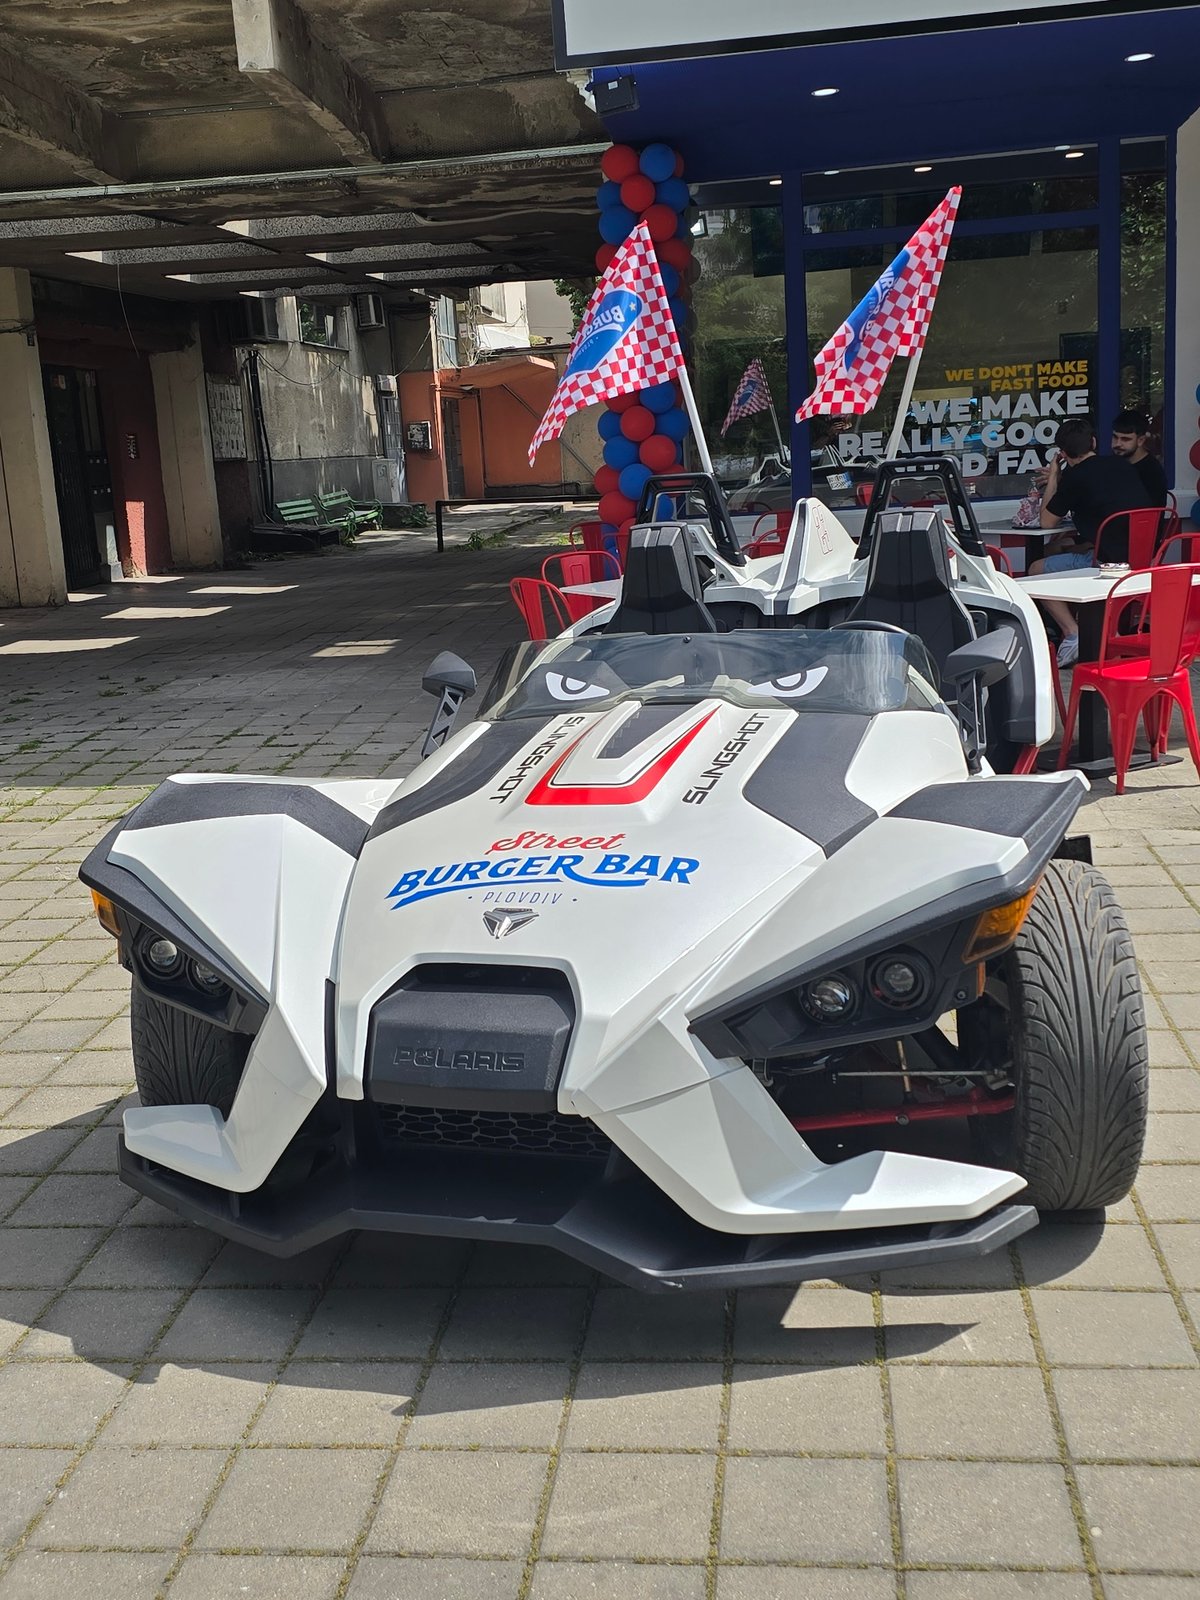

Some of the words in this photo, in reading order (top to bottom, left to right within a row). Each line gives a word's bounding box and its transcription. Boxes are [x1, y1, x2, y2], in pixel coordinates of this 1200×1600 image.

[945, 368, 975, 382] WE
[978, 364, 1034, 379] DON'T
[1037, 360, 1088, 375] MAKE
[991, 377, 1034, 392] FAST
[1038, 374, 1088, 389] FOOD
[911, 397, 972, 425] WE
[982, 389, 1090, 420] MAKE
[838, 425, 972, 458] REALLY
[981, 418, 1081, 449] GOO
[998, 446, 1068, 476] FAS
[489, 715, 586, 804] SLINGSHOT
[682, 712, 771, 805] SLINGSHOT
[484, 830, 627, 855] Street
[384, 853, 585, 901] BURGER
[592, 853, 701, 885] BAR
[482, 890, 563, 905] PLOVDIV
[392, 1047, 526, 1073] POLARIS
